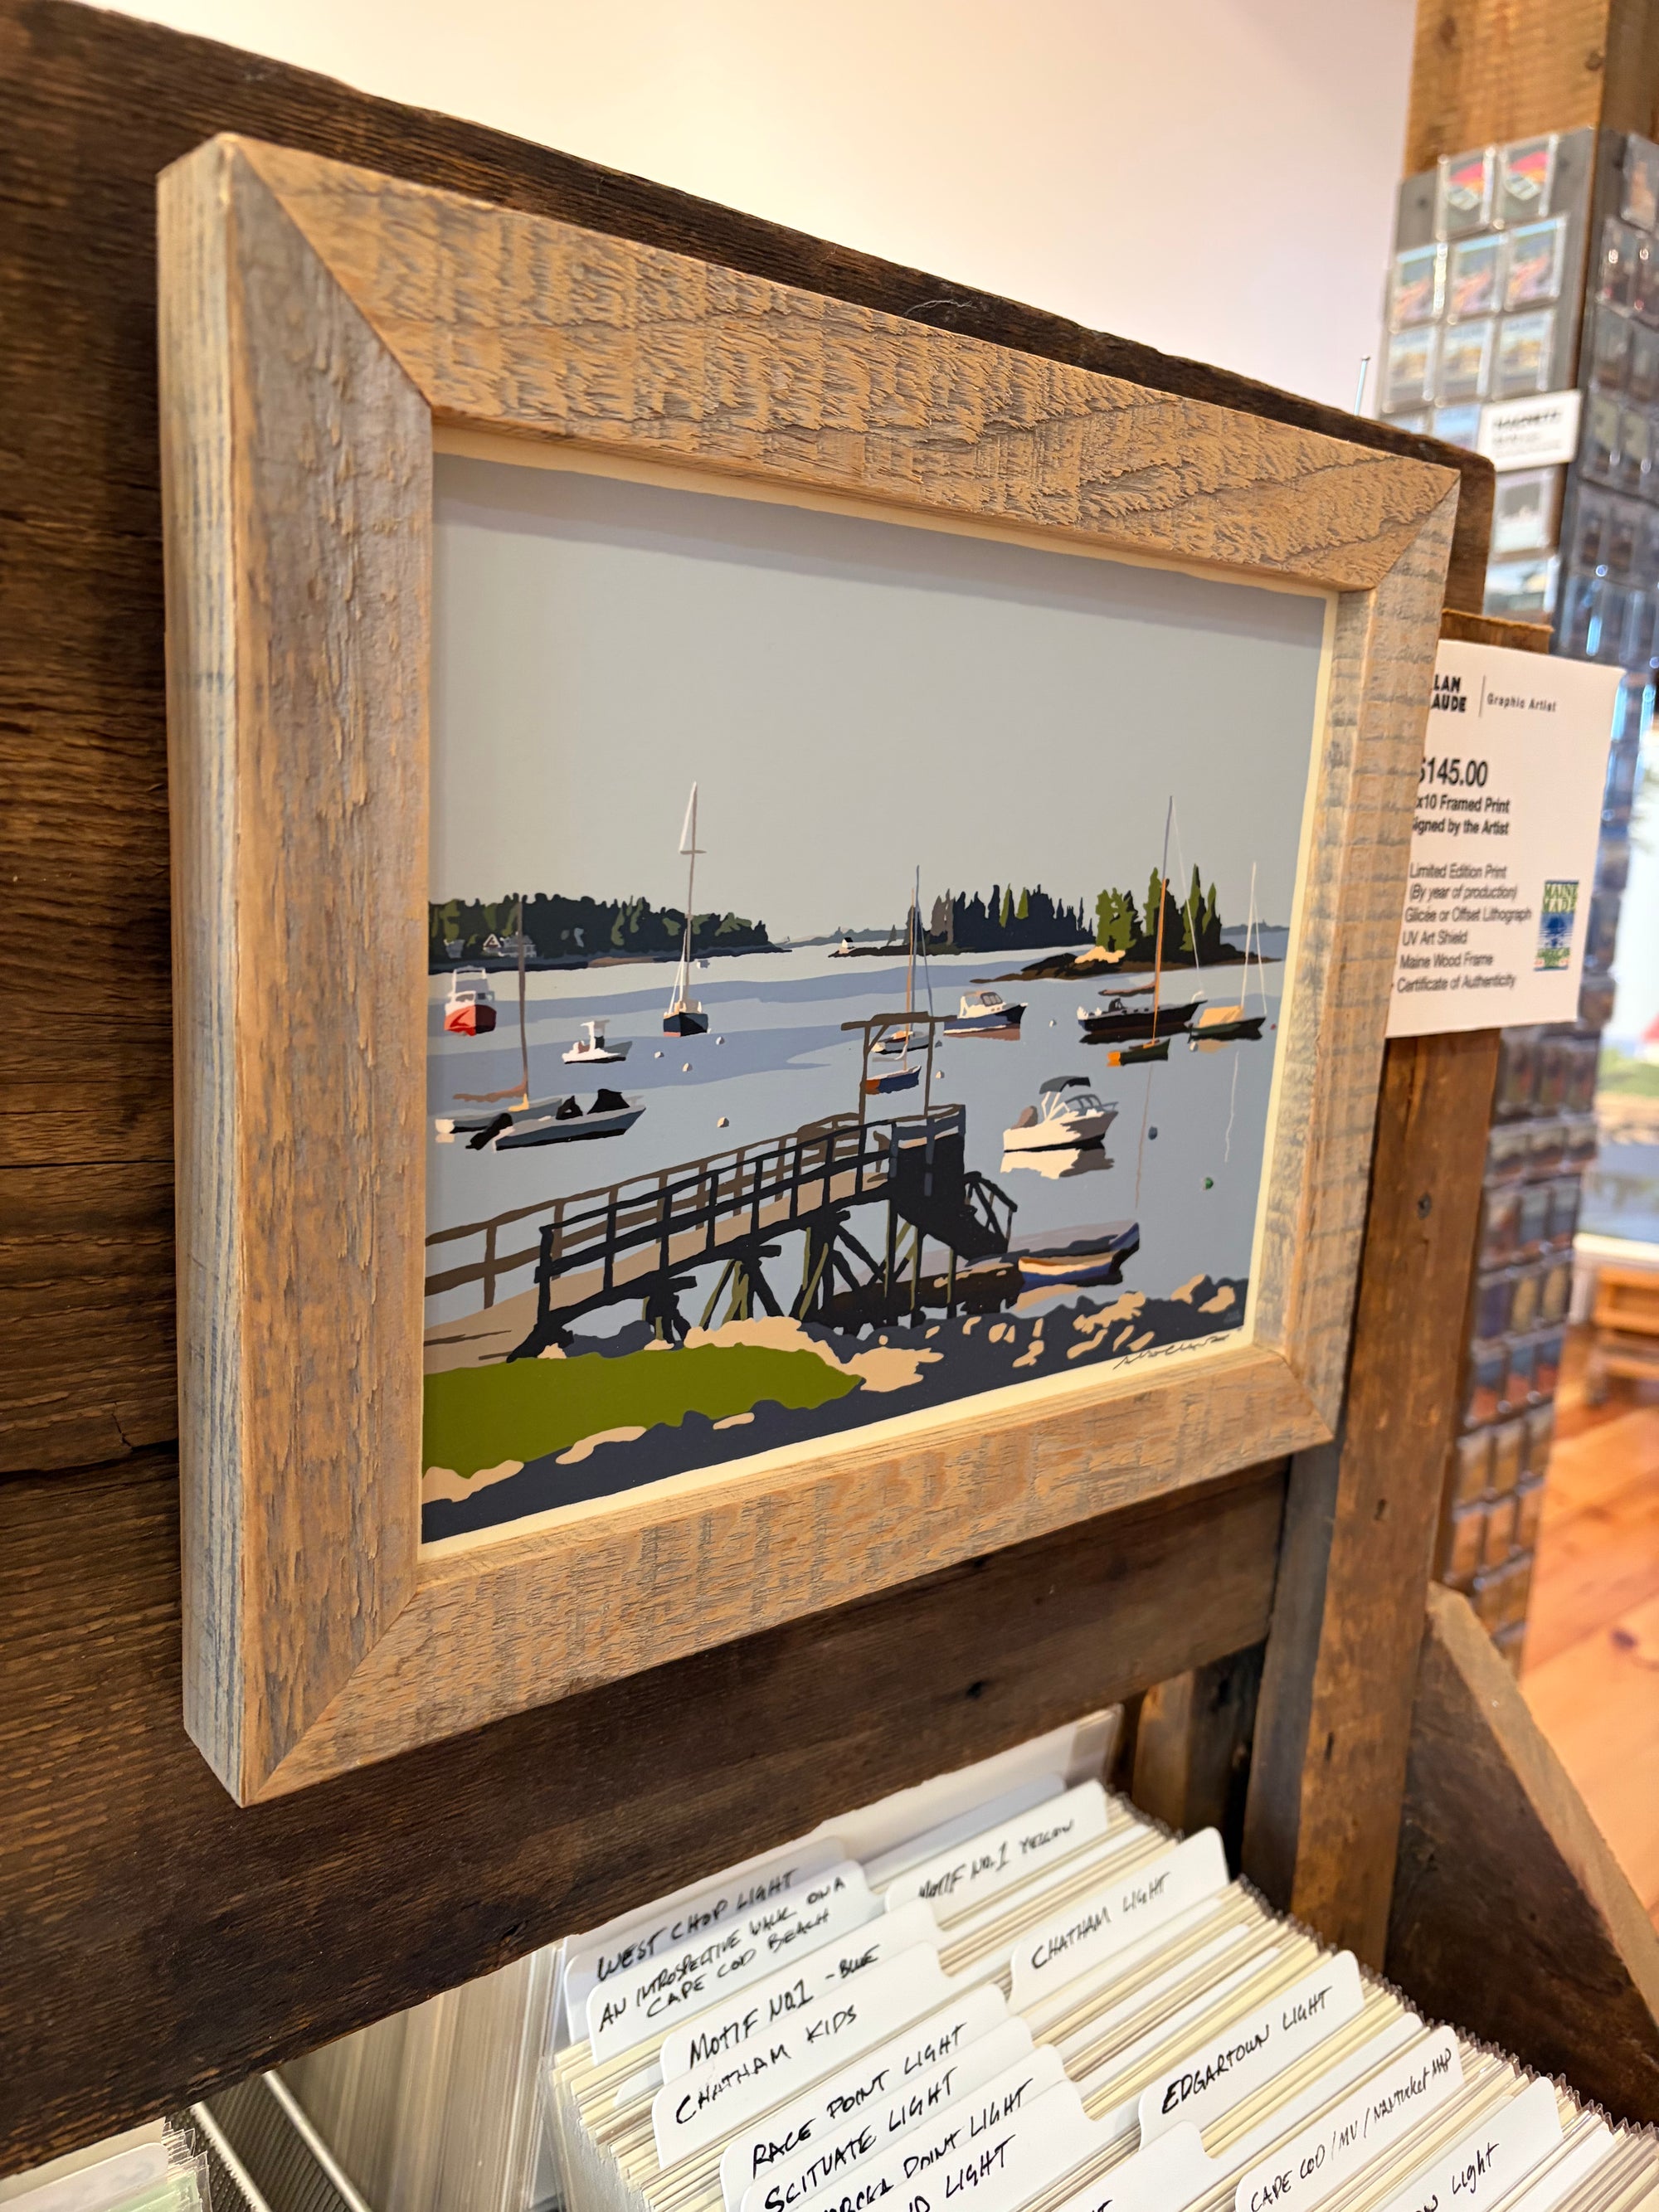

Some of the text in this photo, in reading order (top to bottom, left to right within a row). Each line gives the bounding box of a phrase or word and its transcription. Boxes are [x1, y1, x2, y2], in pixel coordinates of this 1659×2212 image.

[1431, 692, 1557, 713] AUDE Graphic Artist
[1433, 673, 1461, 693] LAN
[1412, 817, 1510, 836] igned by the Artist
[1416, 794, 1510, 814] x10 Framed Print
[1409, 862, 1507, 879] Limited Edition Print
[1428, 887, 1450, 902] year
[1452, 883, 1463, 899] of
[1402, 929, 1468, 946] UV Art Shield
[1439, 910, 1450, 922] or
[1452, 906, 1481, 922] Offset
[1482, 906, 1532, 925] Lithograph
[1397, 974, 1516, 993] Certificate of Authenticity
[1399, 951, 1494, 969] Maine Wood Frame
[918, 1864, 967, 1898] MOTIF
[597, 1868, 798, 1982] WEST CHOP LIGHT
[1031, 1872, 1170, 1969] CHATHAM LIGHT
[599, 1997, 626, 2033] AN
[636, 1929, 742, 2007] INTROSPECTIVE
[749, 1907, 797, 1937] WALK
[646, 1908, 829, 2018] CAPE COD BEACH
[676, 2005, 857, 2124] CHATHAM KIDS
[690, 2008, 758, 2069] MOTIF
[1161, 1986, 1333, 2114] EDGARTOWN LIGHT
[752, 2022, 967, 2180] RACE POINT LIGHT
[971, 2078, 1034, 2138] LIGHT
[765, 2066, 958, 2212] SCITUATE LIGHT
[946, 2134, 1016, 2198] LIGHT
[1251, 2170, 1293, 2212] CAPE
[1300, 2144, 1326, 2179] COD
